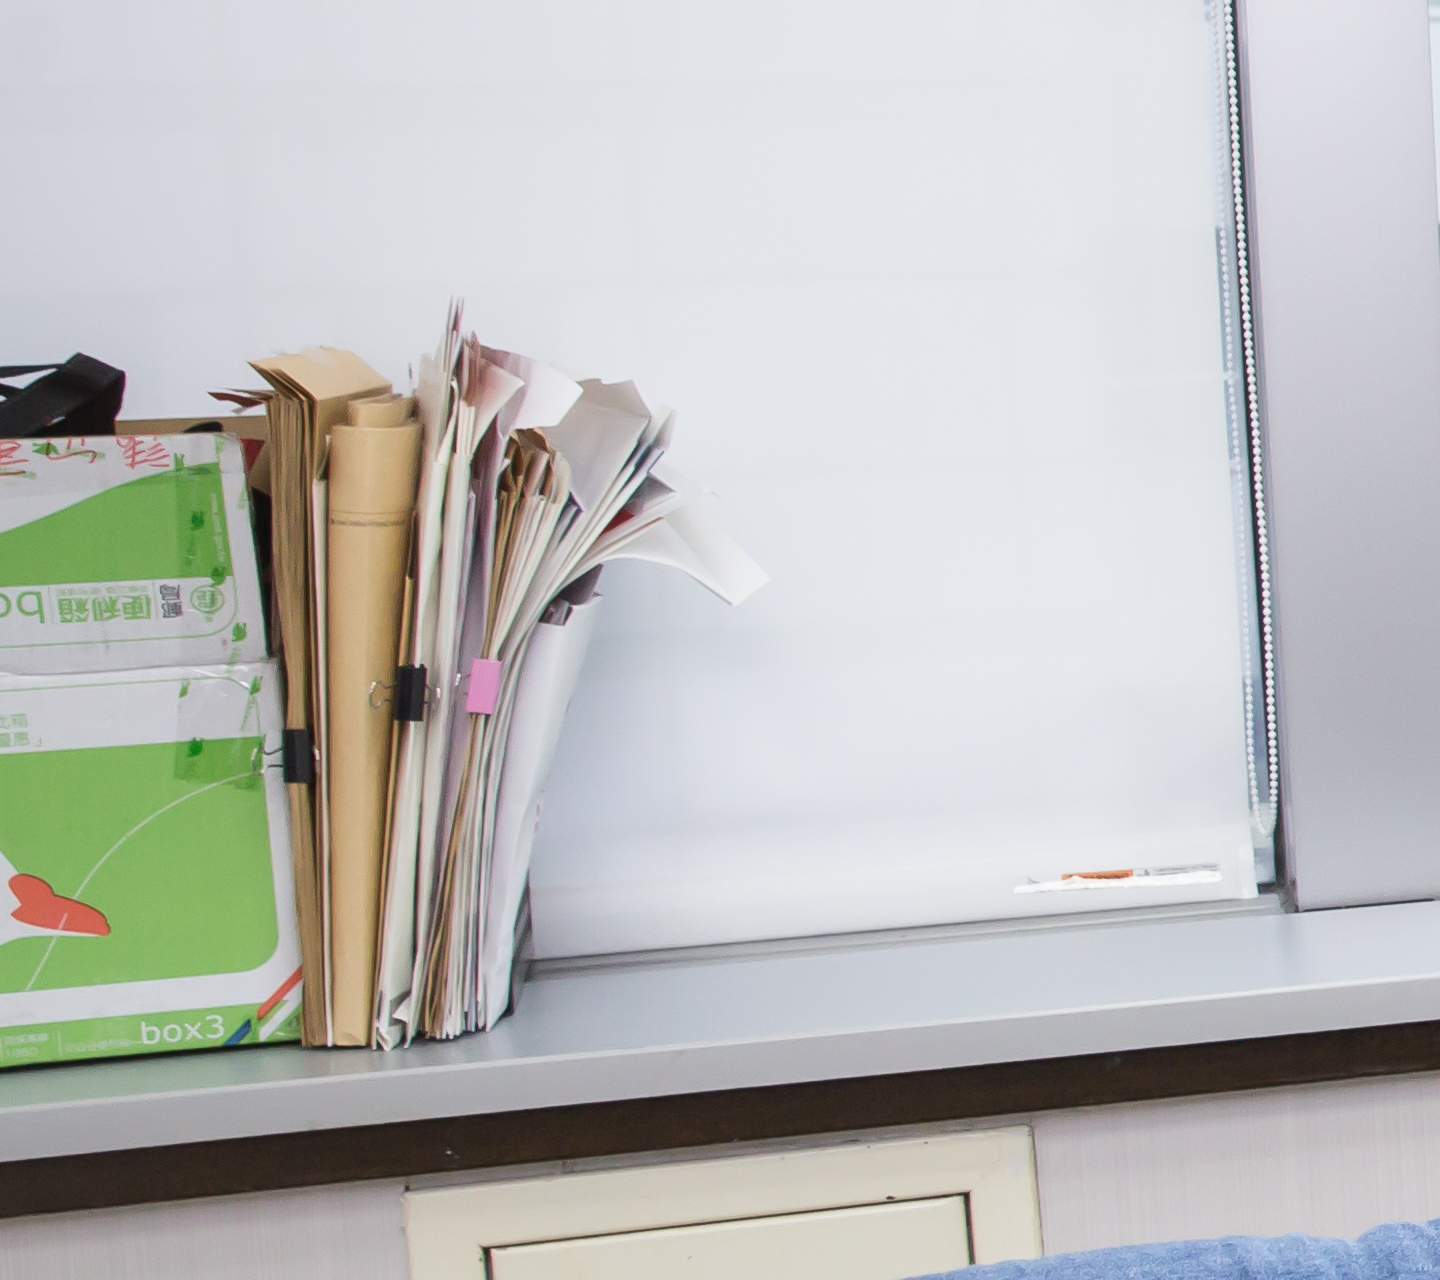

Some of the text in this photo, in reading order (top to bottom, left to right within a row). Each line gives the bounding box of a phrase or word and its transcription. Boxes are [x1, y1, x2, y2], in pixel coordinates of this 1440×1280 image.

[57, 592, 152, 624] 便利箱
[140, 1014, 225, 1045] box3
